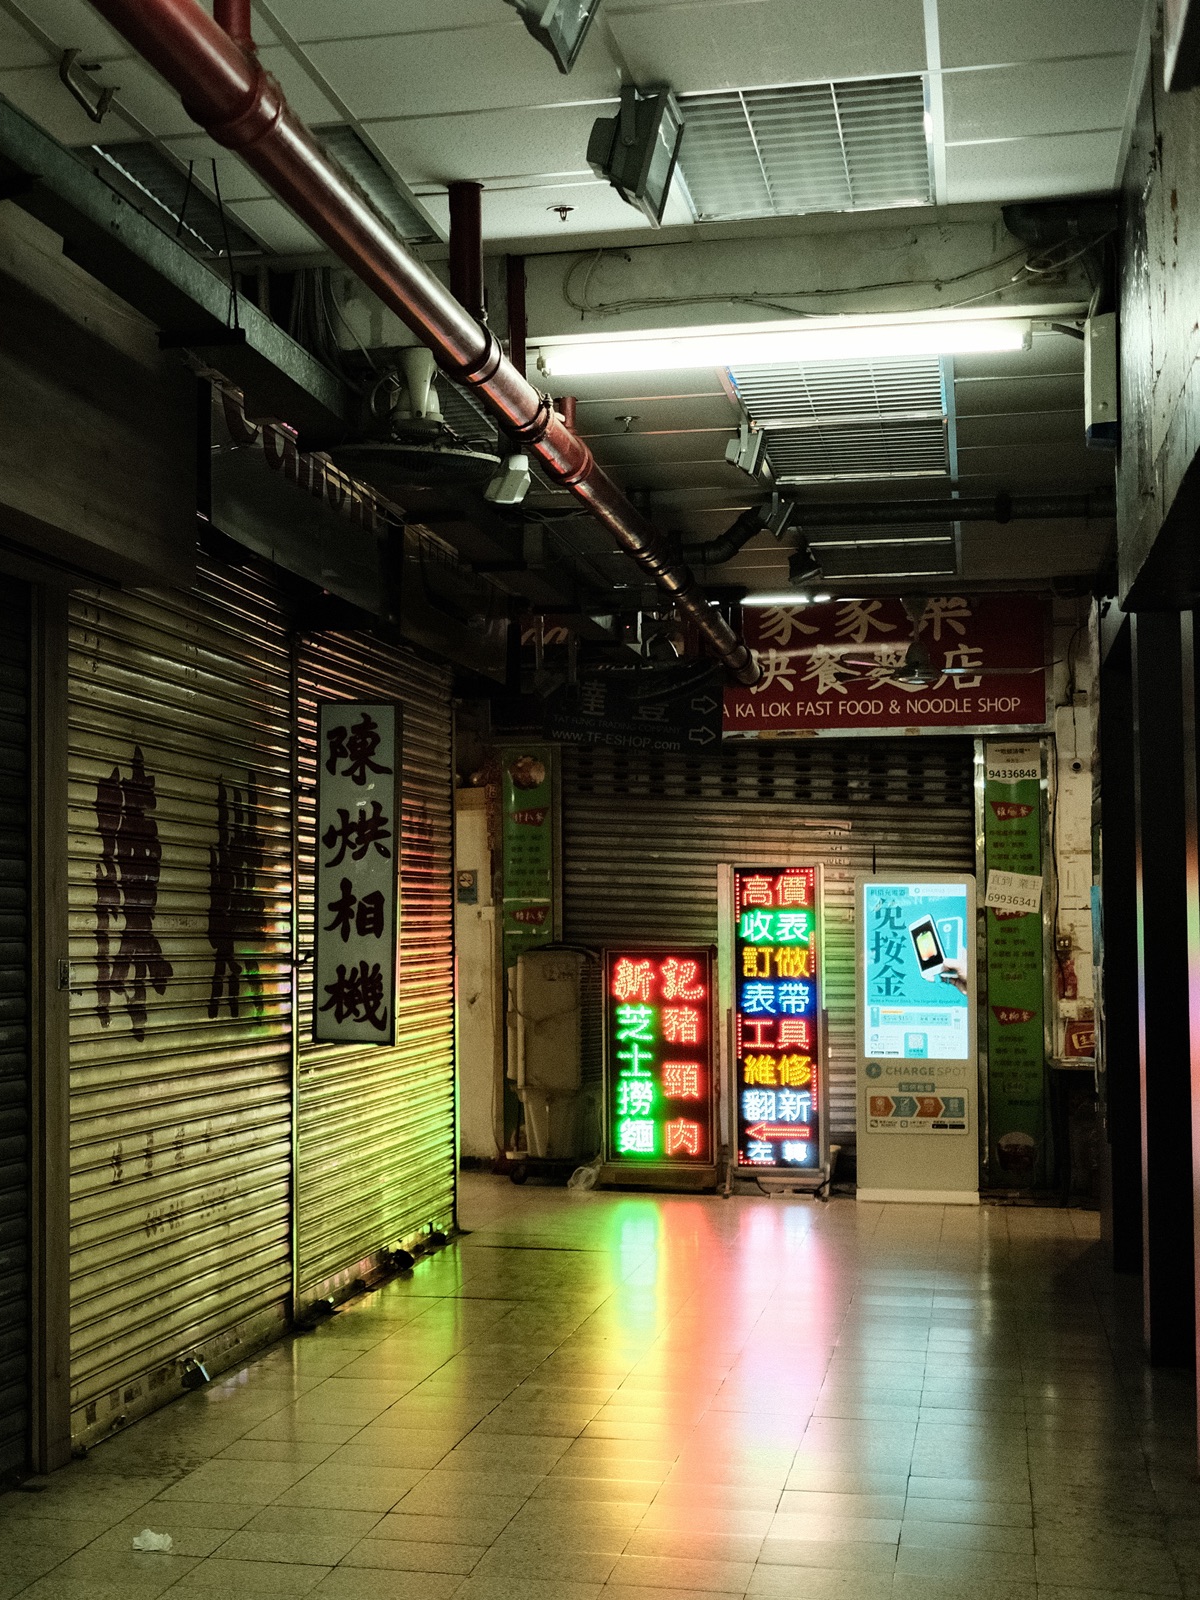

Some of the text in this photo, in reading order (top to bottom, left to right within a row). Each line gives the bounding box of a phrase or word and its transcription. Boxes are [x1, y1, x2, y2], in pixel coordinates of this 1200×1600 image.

[735, 703, 756, 718] KA
[761, 702, 792, 717] LOK
[796, 701, 833, 716] FAST
[838, 700, 884, 715] FOOD
[889, 699, 901, 714] &
[906, 698, 972, 714] NOODLE
[978, 697, 1021, 713] SHOP
[551, 730, 681, 751] www.TF-ESHOP.com
[988, 768, 1038, 779] 94336848
[317, 711, 394, 1033] 陳烘相機
[742, 874, 809, 907] 高價
[987, 892, 1037, 908] 69936341
[742, 911, 810, 942] 收表
[742, 946, 811, 978] 訂做
[870, 897, 907, 998] 免按金
[615, 958, 704, 1001] 新記
[743, 982, 811, 1014] 表帶
[743, 1018, 810, 1050] 工具
[616, 1004, 655, 1154] 芝士撈麵
[663, 1005, 700, 1156] 豬頸肉
[743, 1053, 812, 1087] 維修
[743, 1089, 811, 1122] 翻新
